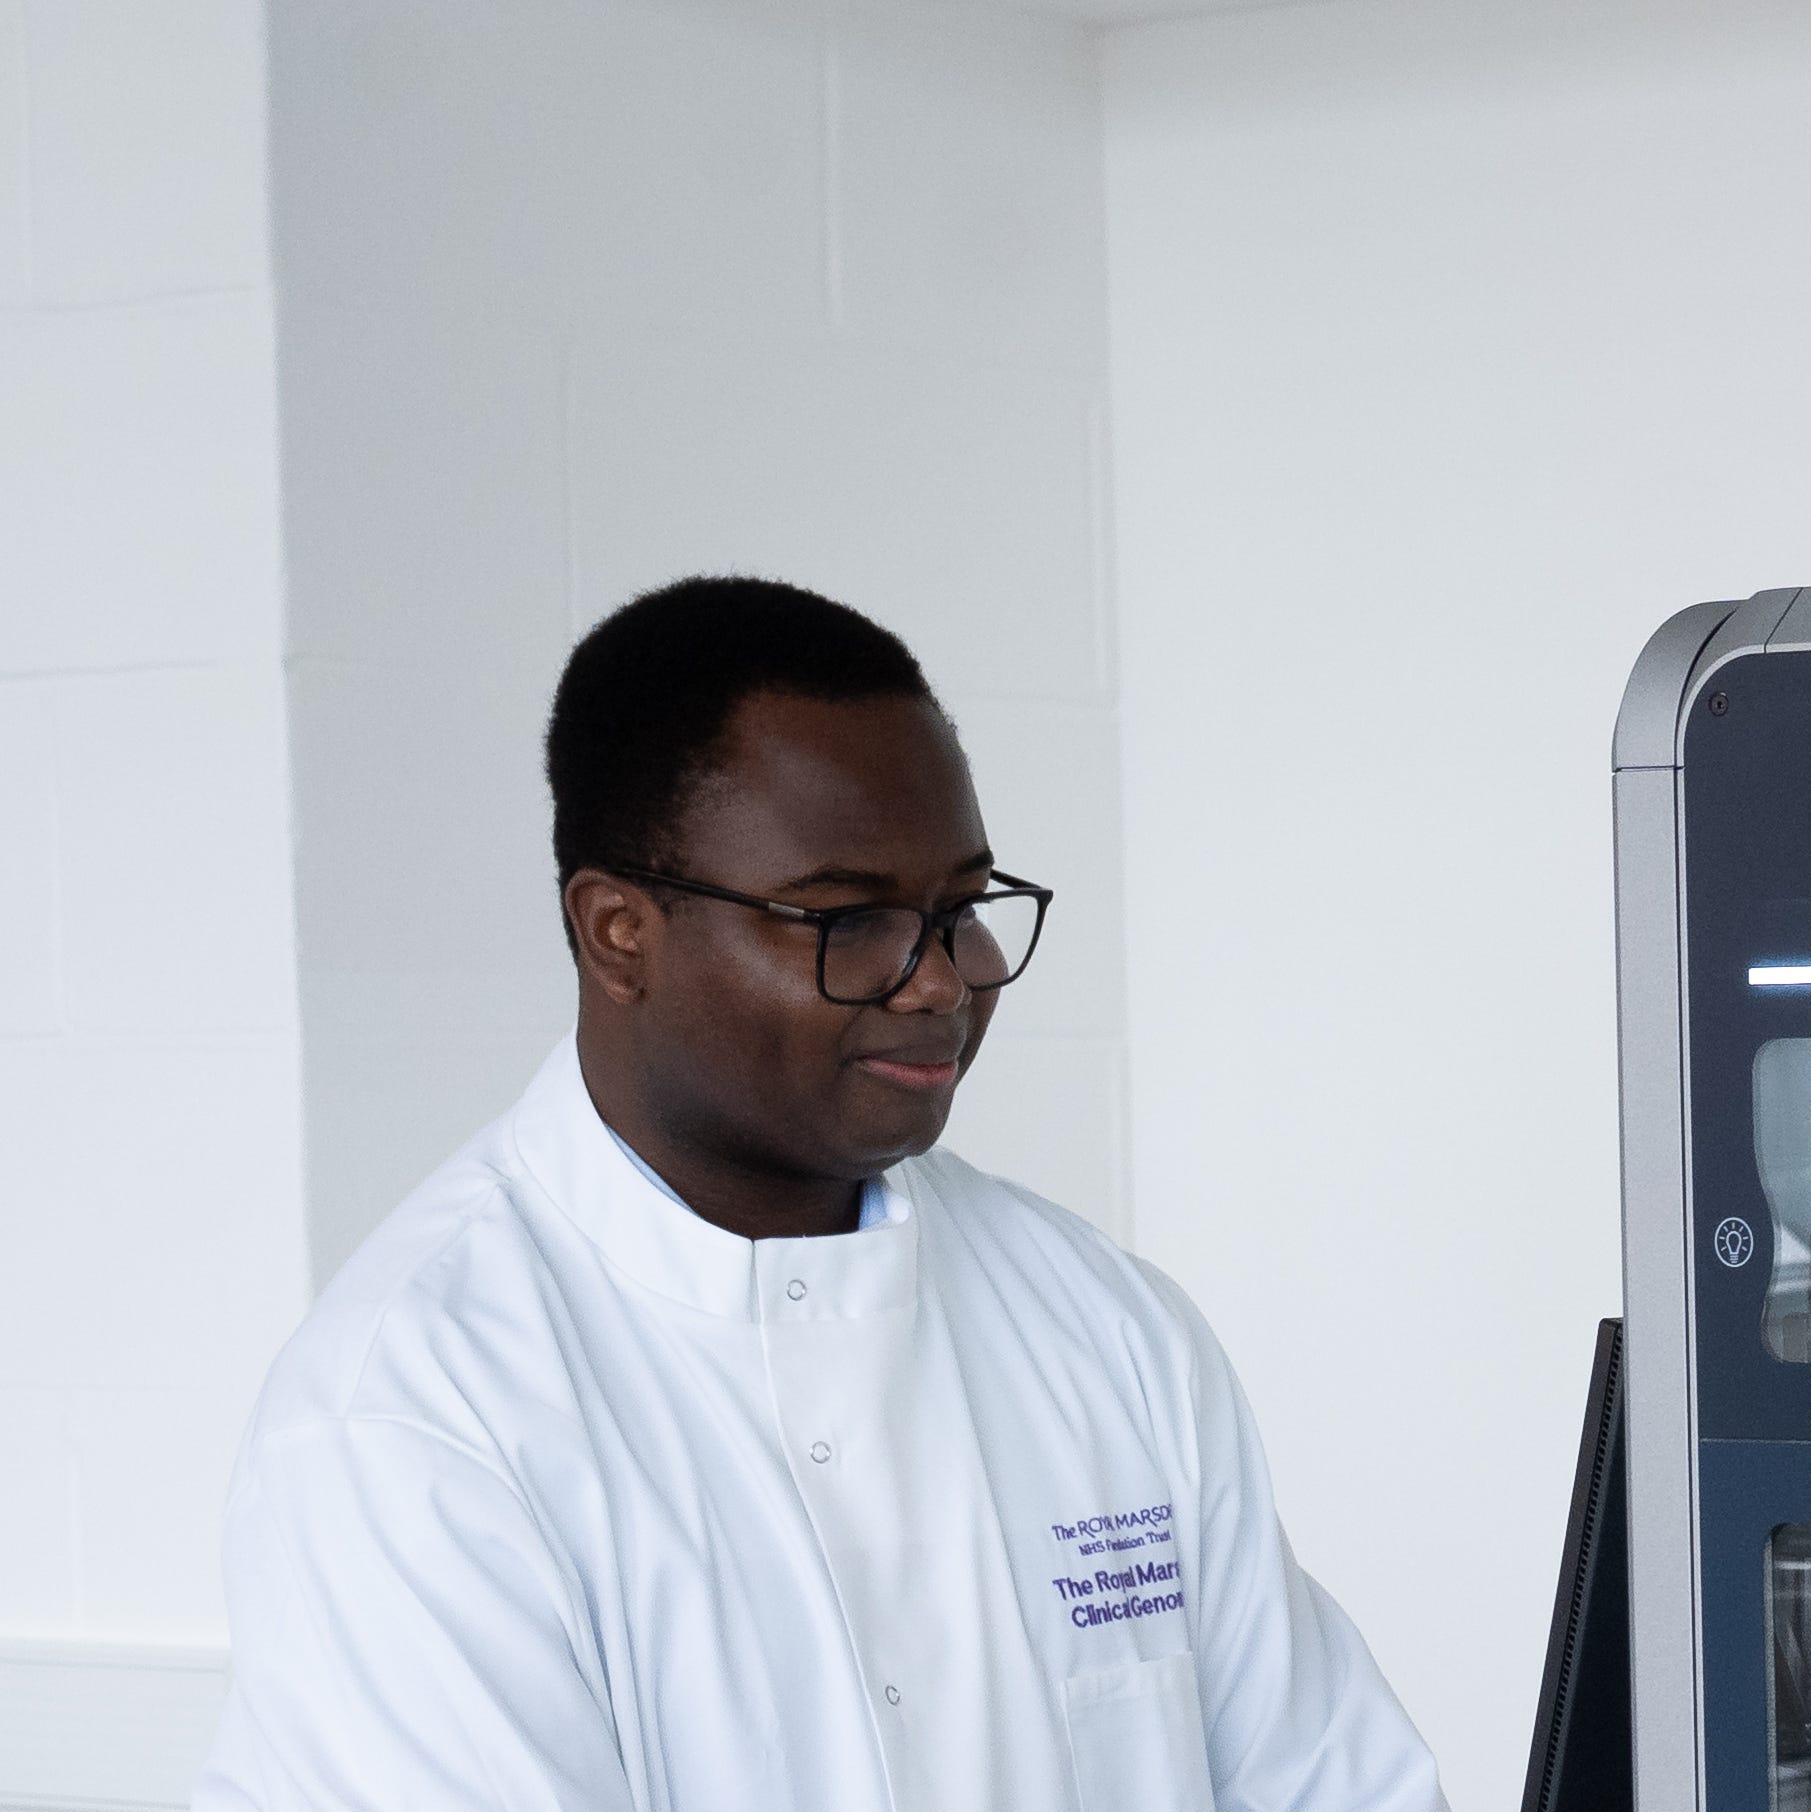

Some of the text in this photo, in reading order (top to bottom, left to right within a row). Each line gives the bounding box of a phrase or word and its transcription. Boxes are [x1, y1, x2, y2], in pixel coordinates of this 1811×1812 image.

[1051, 1524, 1077, 1541] The
[1078, 1539, 1106, 1556] NHS
[1051, 1576, 1094, 1601] The
